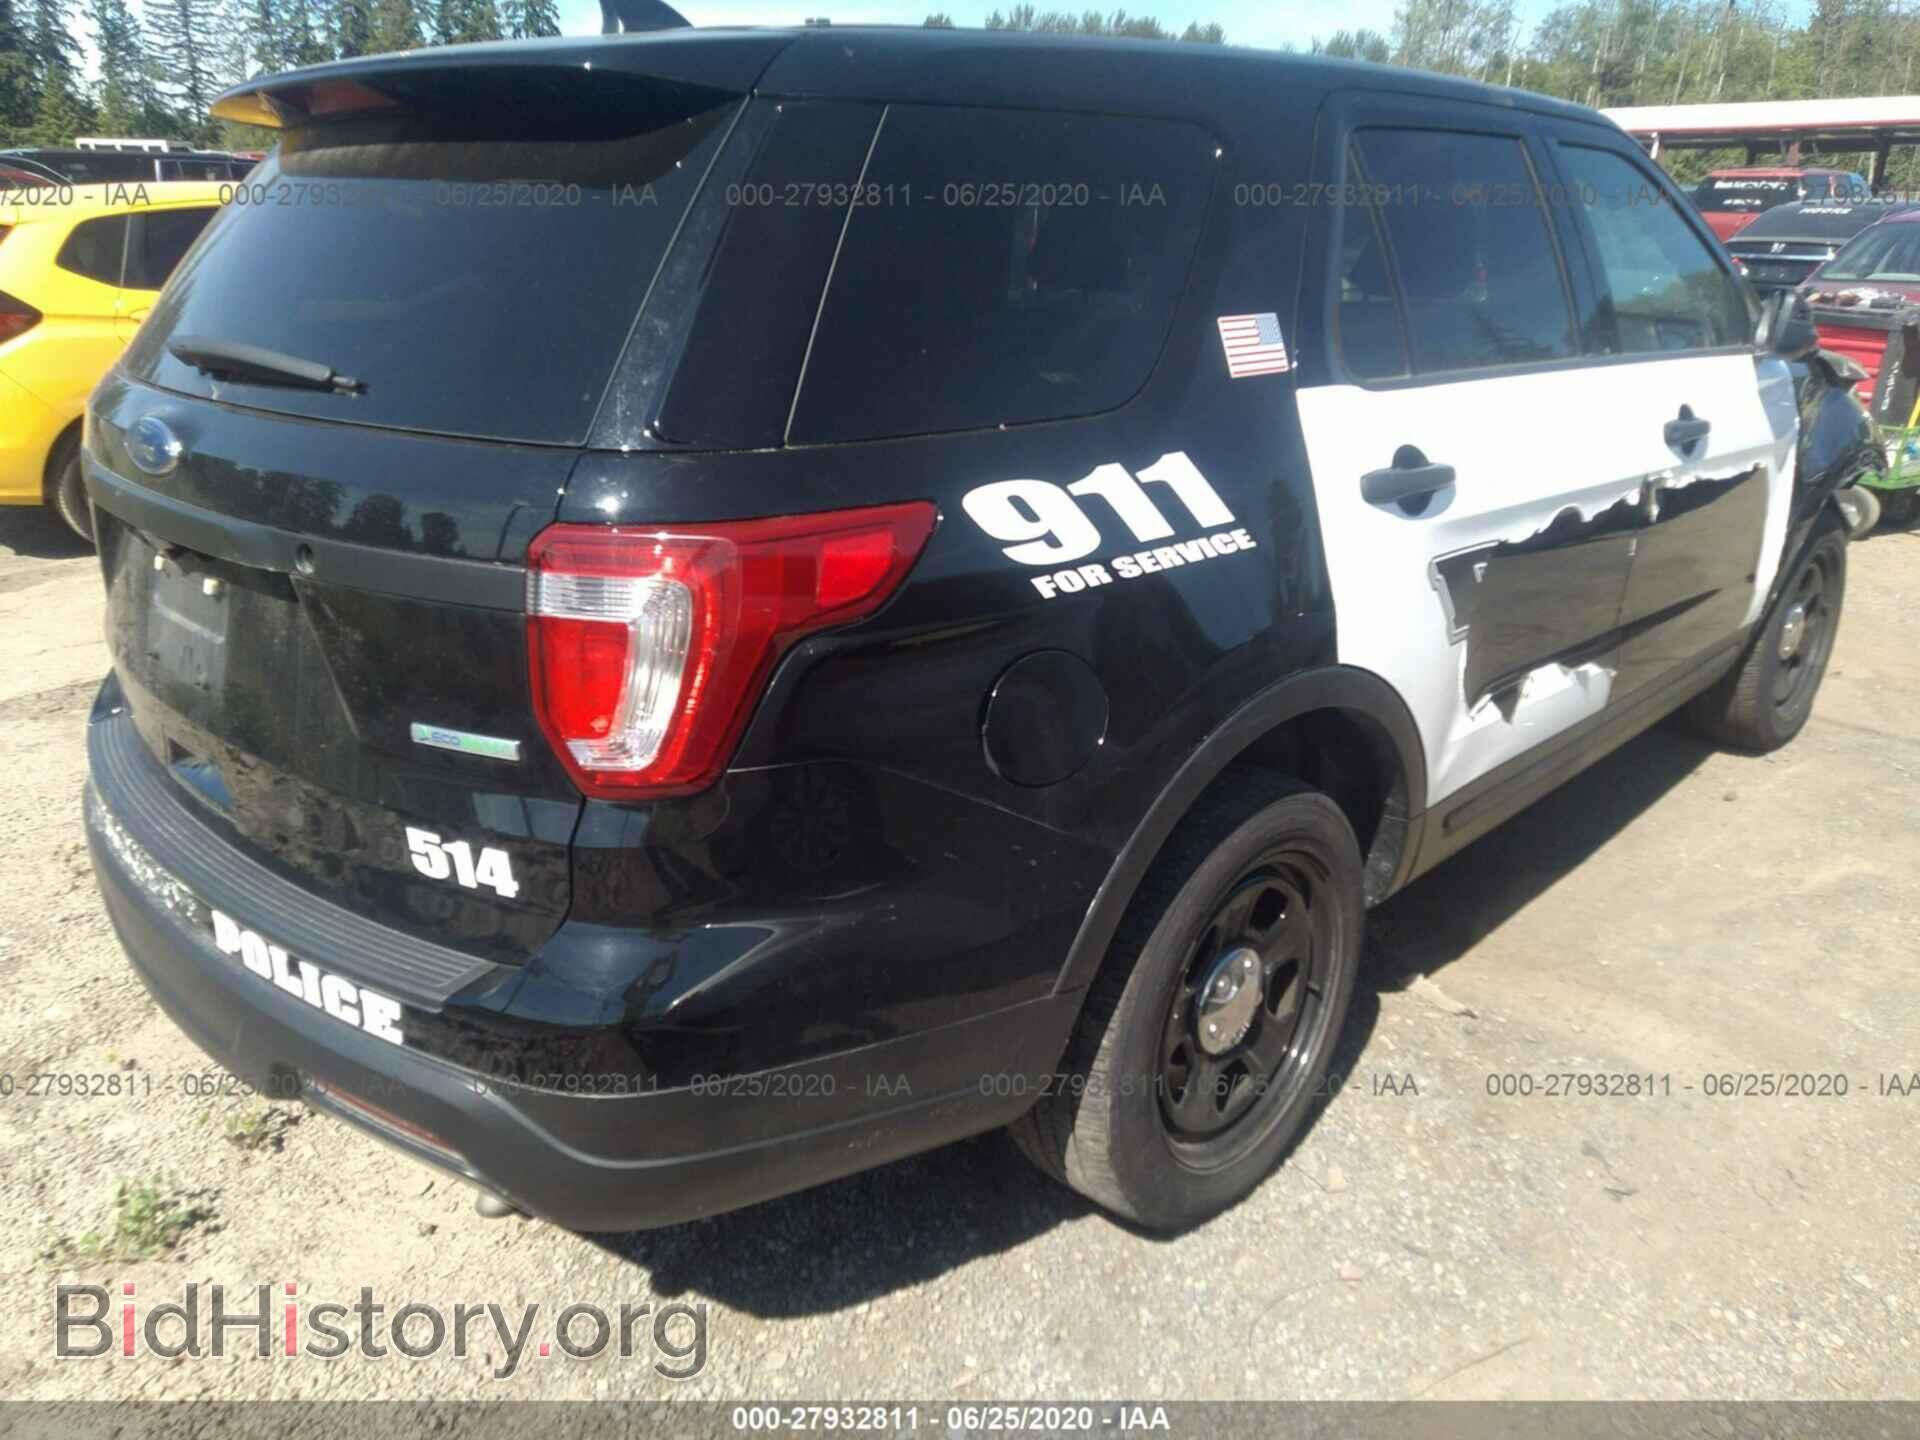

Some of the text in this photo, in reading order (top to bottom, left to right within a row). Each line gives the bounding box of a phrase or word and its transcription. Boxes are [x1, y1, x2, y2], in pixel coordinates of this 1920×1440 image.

[962, 451, 1236, 565] 911
[1030, 528, 1257, 599] FOR SERVICE
[405, 827, 519, 898] 514
[211, 910, 404, 1045] POLICE
